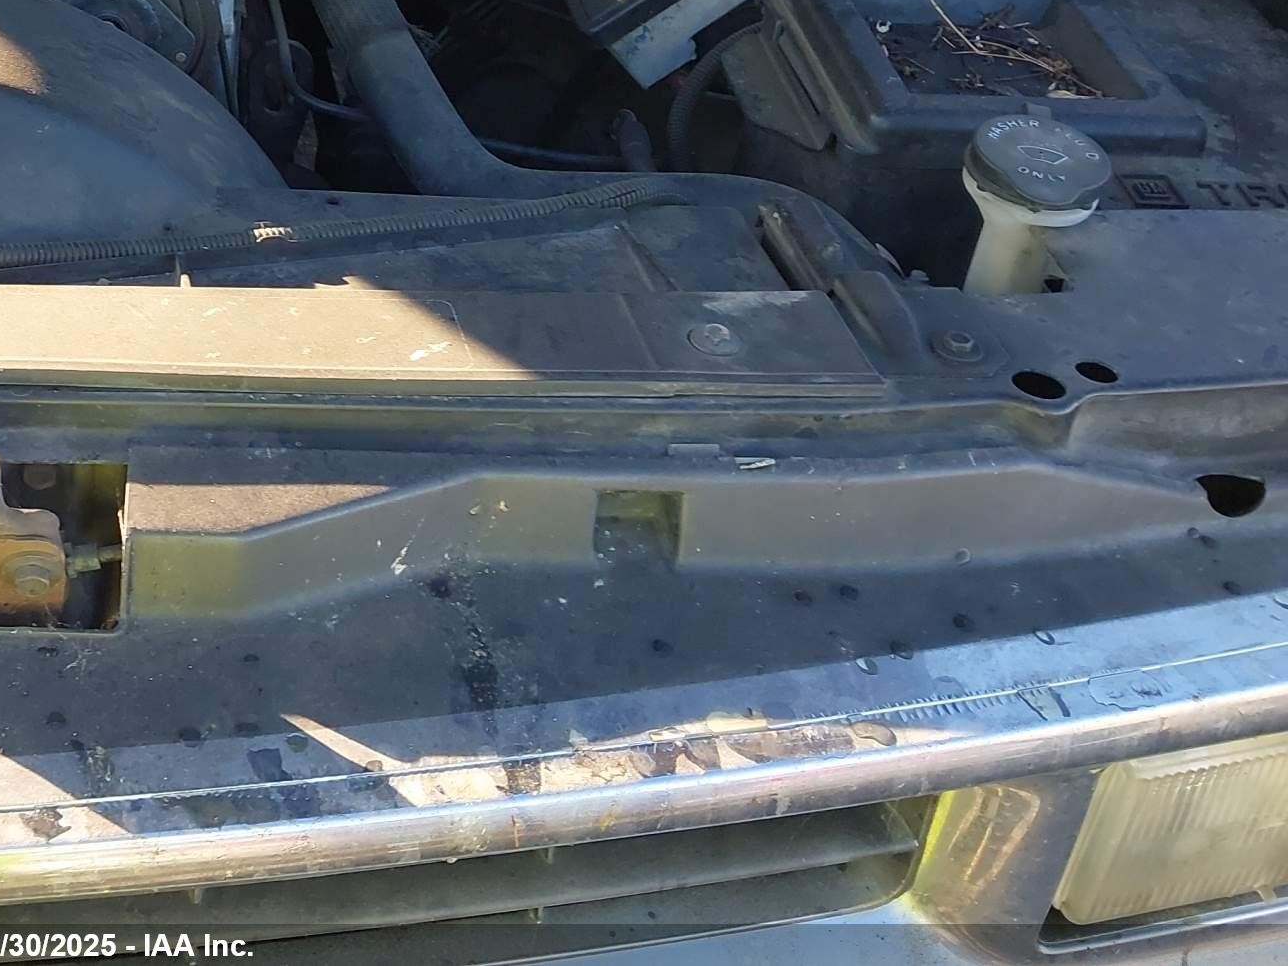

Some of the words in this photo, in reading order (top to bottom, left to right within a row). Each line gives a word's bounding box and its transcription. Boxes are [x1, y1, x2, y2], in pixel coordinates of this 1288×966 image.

[987, 118, 1041, 140] WASHER
[1055, 128, 1101, 161] LUD
[1017, 165, 1066, 183] ONLY
